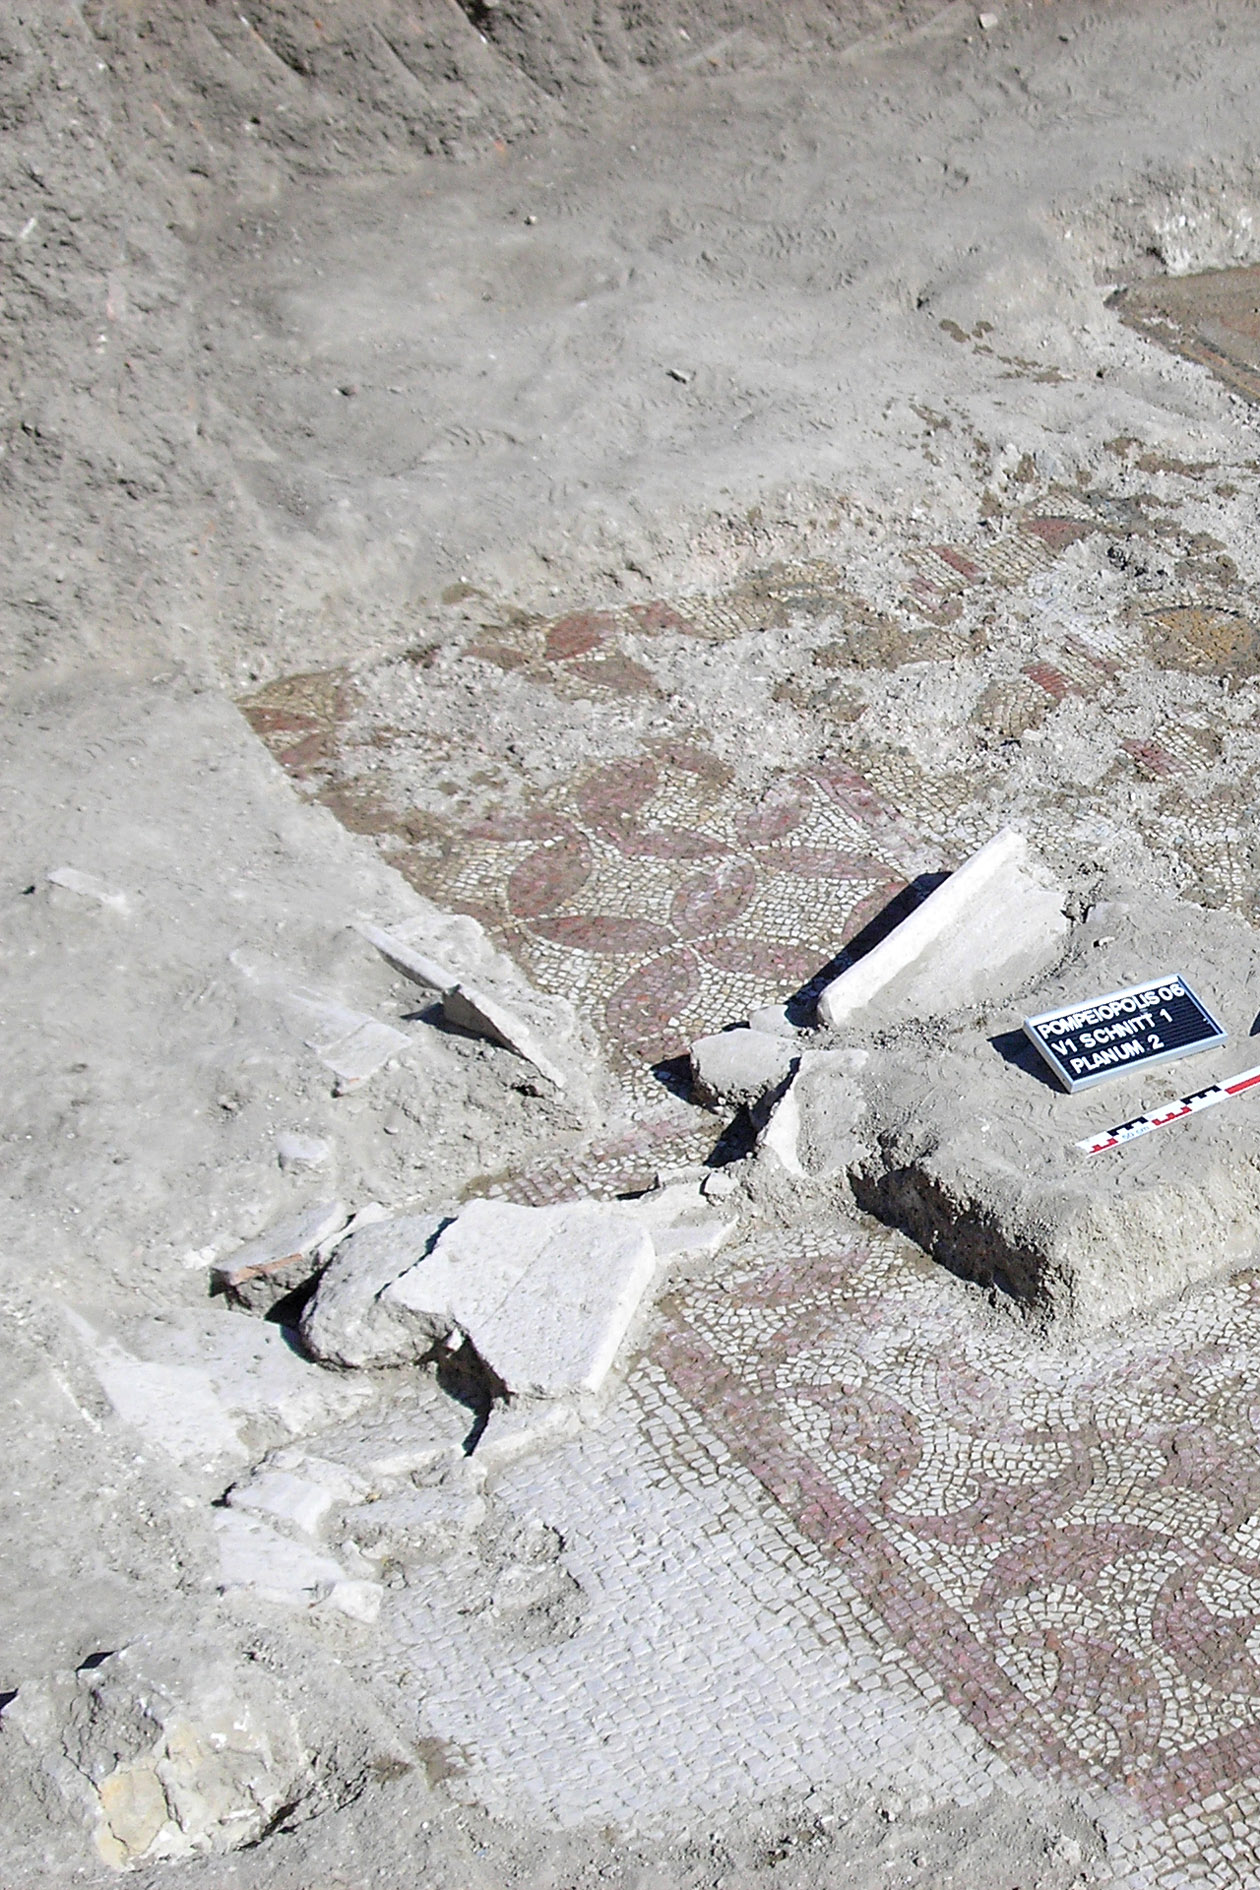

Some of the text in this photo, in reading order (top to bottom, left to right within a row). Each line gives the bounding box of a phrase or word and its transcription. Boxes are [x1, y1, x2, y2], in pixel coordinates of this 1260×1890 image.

[1037, 993, 1159, 1039] POMPEIOPOLIS
[1052, 1008, 1173, 1056] V1 SCHNITT 1
[1069, 1034, 1164, 1074] PLANUM 2
